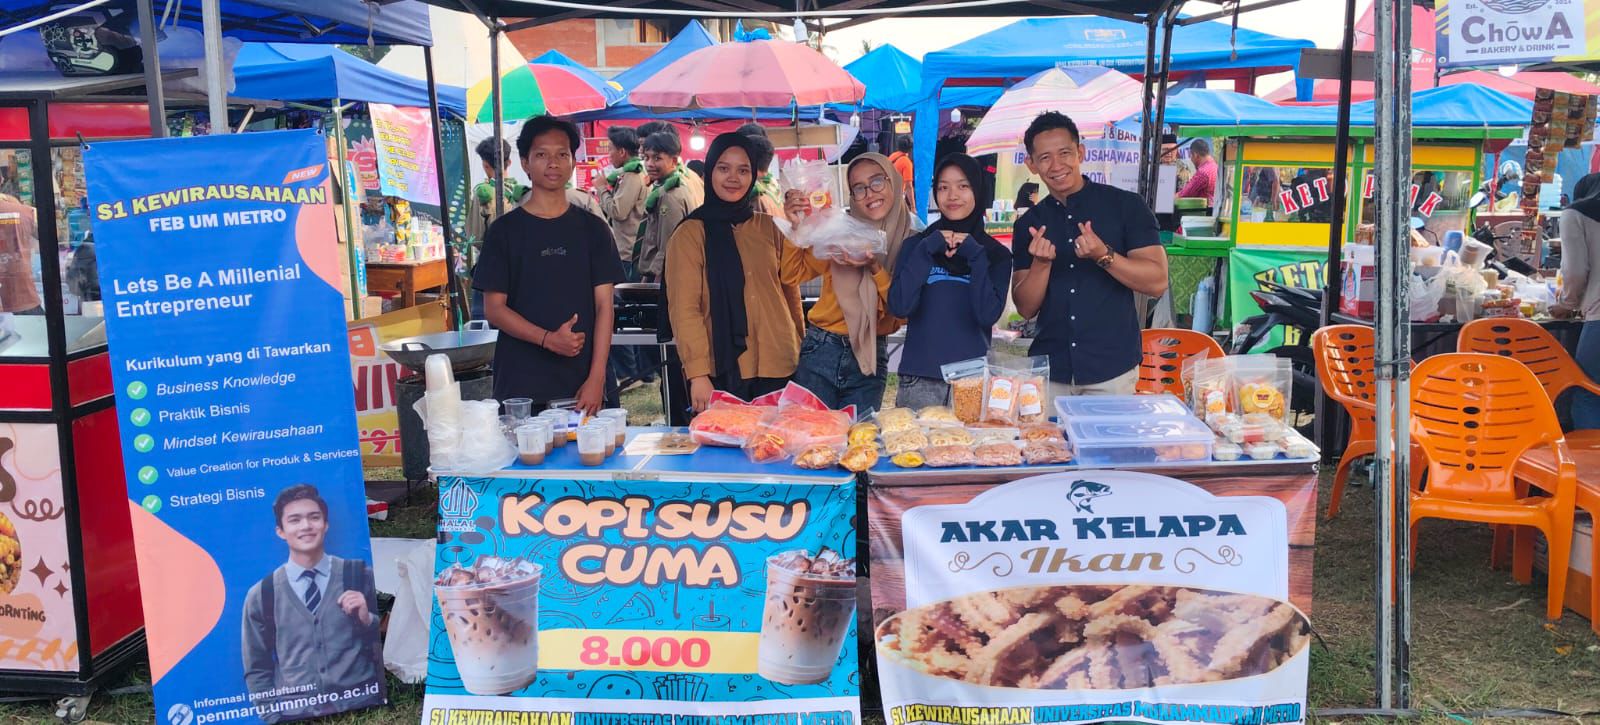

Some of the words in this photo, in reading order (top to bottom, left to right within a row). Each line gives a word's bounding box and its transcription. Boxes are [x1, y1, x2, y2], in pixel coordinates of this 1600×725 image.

[1480, 46, 1517, 54] BAKERY
[1526, 44, 1555, 52] DRINK
[291, 167, 318, 180] NEW
[97, 202, 128, 220] S1
[132, 184, 326, 215] KEWIRAUSAHAAN
[150, 215, 184, 232] FEB
[189, 212, 218, 229] UM
[223, 209, 286, 225] METRO
[113, 278, 158, 295] Lets
[165, 273, 192, 290] Be
[198, 272, 213, 287] A
[218, 264, 301, 285] Millenial
[116, 292, 253, 317] Entrepreneur
[126, 354, 203, 371] Kurikulum
[206, 349, 243, 366] yang
[246, 347, 260, 359] di
[263, 342, 331, 358] Tawarkan
[156, 379, 218, 396] Business
[223, 372, 296, 389] Knowledge
[159, 407, 206, 422] Praktik
[210, 402, 250, 417] Bisnis
[163, 433, 217, 450] Mindset
[221, 423, 323, 444] Kewirausahaan
[167, 465, 197, 478] Value
[200, 460, 244, 473] Creation
[245, 458, 260, 470] for
[262, 454, 300, 467] Produk
[303, 453, 311, 463] &
[314, 448, 359, 461] Services
[170, 490, 223, 507] Strategi
[226, 486, 265, 501] Bisnis
[440, 519, 476, 528] HALAL
[500, 493, 652, 539] KOPI
[655, 499, 808, 541] SUSU
[940, 518, 1059, 543] AKAR
[1073, 514, 1247, 540] KELAPA
[560, 542, 740, 587] CUMA
[1020, 546, 1165, 574] Ikan
[580, 635, 711, 668] 8.000
[194, 694, 246, 709] Informasi
[249, 682, 317, 701] pendaftaran:
[196, 682, 379, 725] penmaru.ummetro.ac.id
[430, 708, 447, 725] S1
[448, 709, 573, 725] KEWIRAUSAHAAN
[574, 712, 672, 725] UNIVERSITAS
[674, 711, 798, 725] MUHAMMADIYAH
[800, 710, 853, 725] METRO
[890, 706, 905, 725] S1
[905, 703, 1032, 725] KEWIRAUSAHAAN
[1033, 701, 1132, 724] UNIVERSITAS
[1134, 700, 1264, 725] MUHAMMADIYAH
[1263, 703, 1301, 724] METRO
